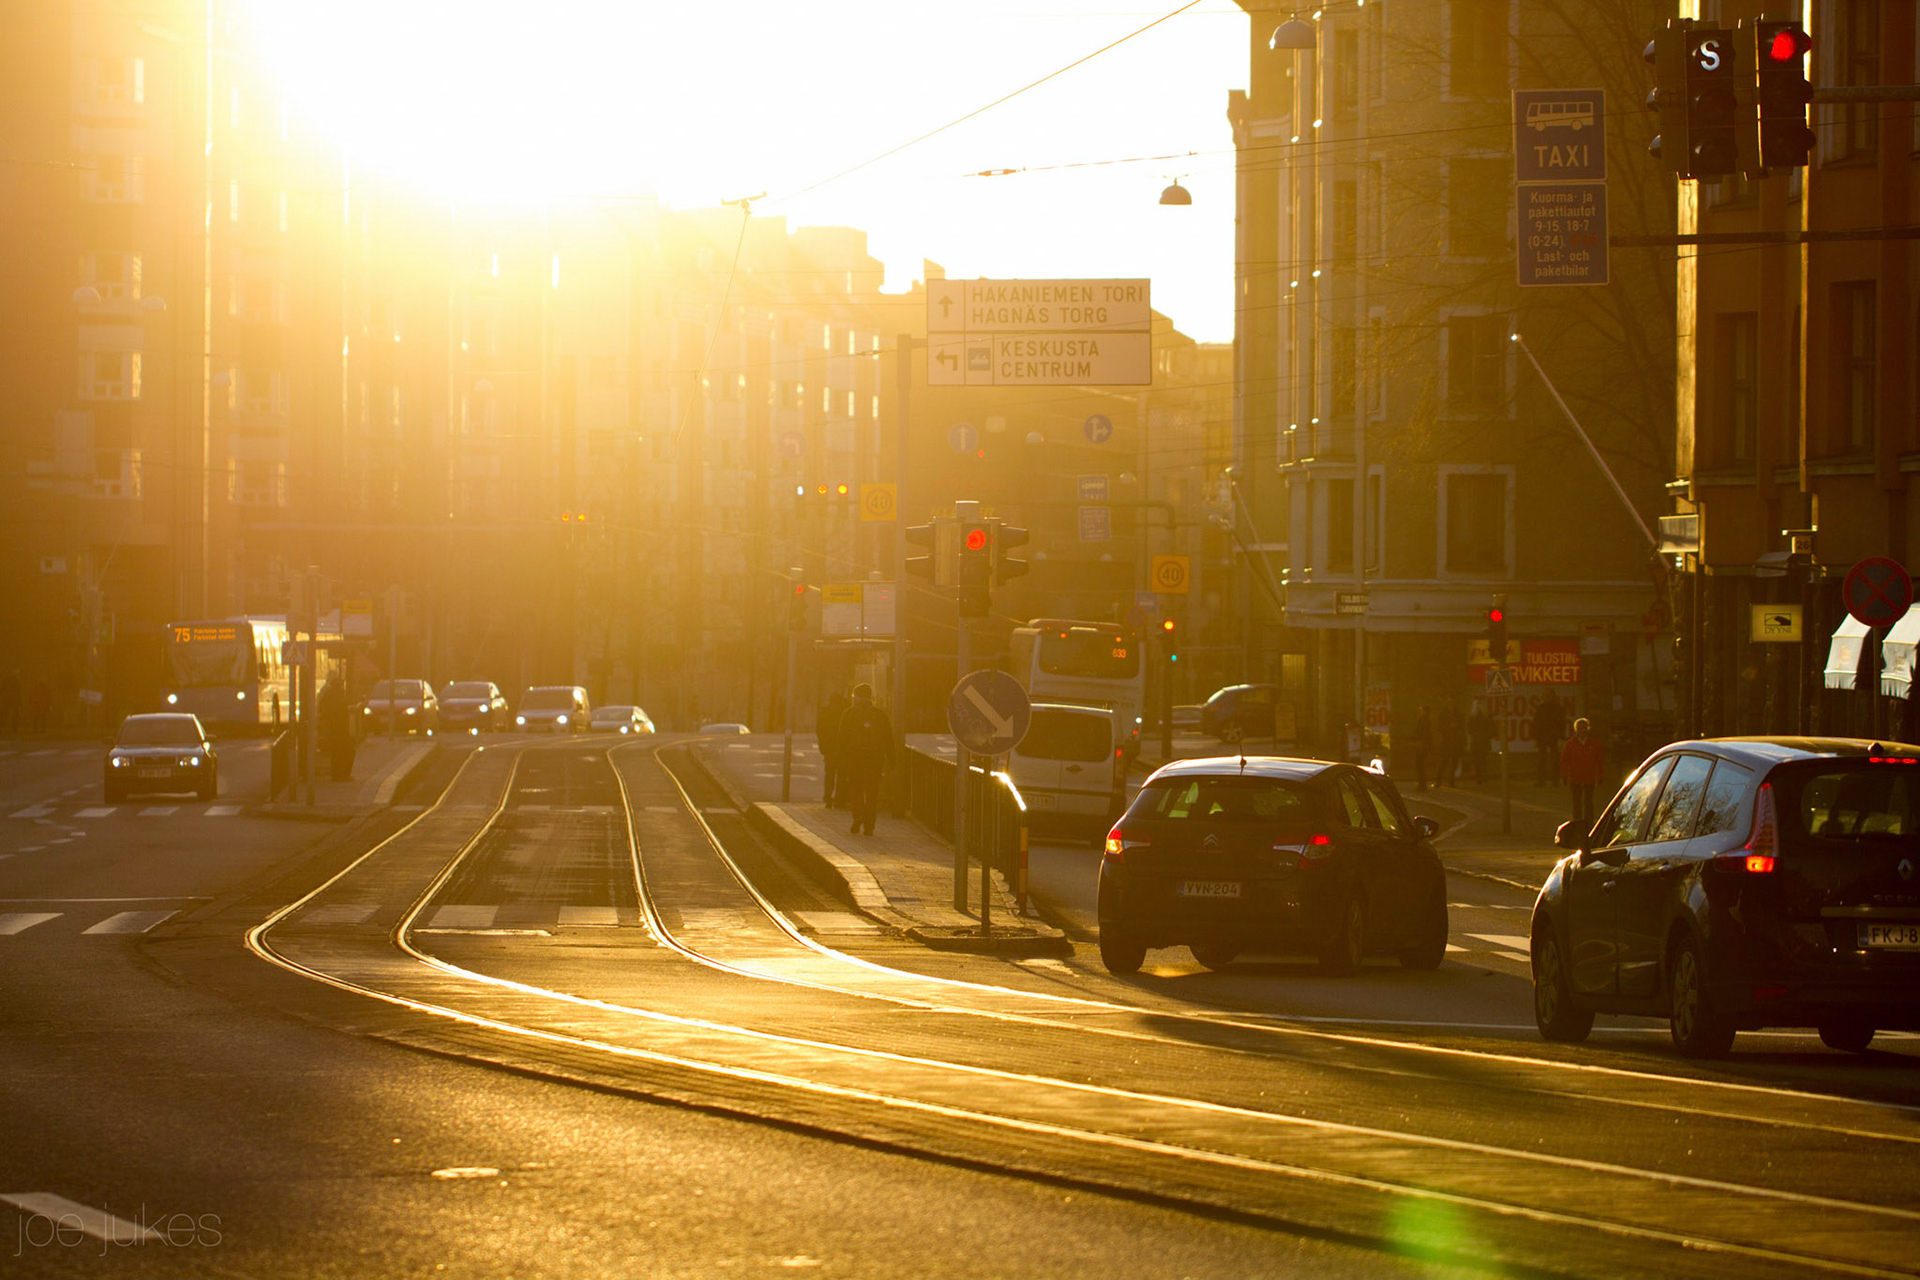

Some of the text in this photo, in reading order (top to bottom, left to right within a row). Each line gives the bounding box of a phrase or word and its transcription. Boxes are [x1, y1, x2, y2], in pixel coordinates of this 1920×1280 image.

[1533, 145, 1588, 168] TAXI
[1530, 191, 1593, 204] Kuorma- ja
[1528, 205, 1596, 219] pakettiautot
[1567, 220, 1589, 231] 18-7
[1536, 250, 1589, 262] Last- och
[1535, 265, 1589, 278] paketbilar
[971, 286, 1143, 302] HAKANIEMEN TORI
[971, 305, 1108, 323] HAGNÄS TORG
[1000, 340, 1100, 357] KESKUSTA
[1001, 362, 1091, 378] CENTRUM
[871, 495, 888, 509] 40
[1162, 567, 1179, 582] 40
[174, 627, 191, 643] 75
[1526, 652, 1580, 664] TULOSTIN-
